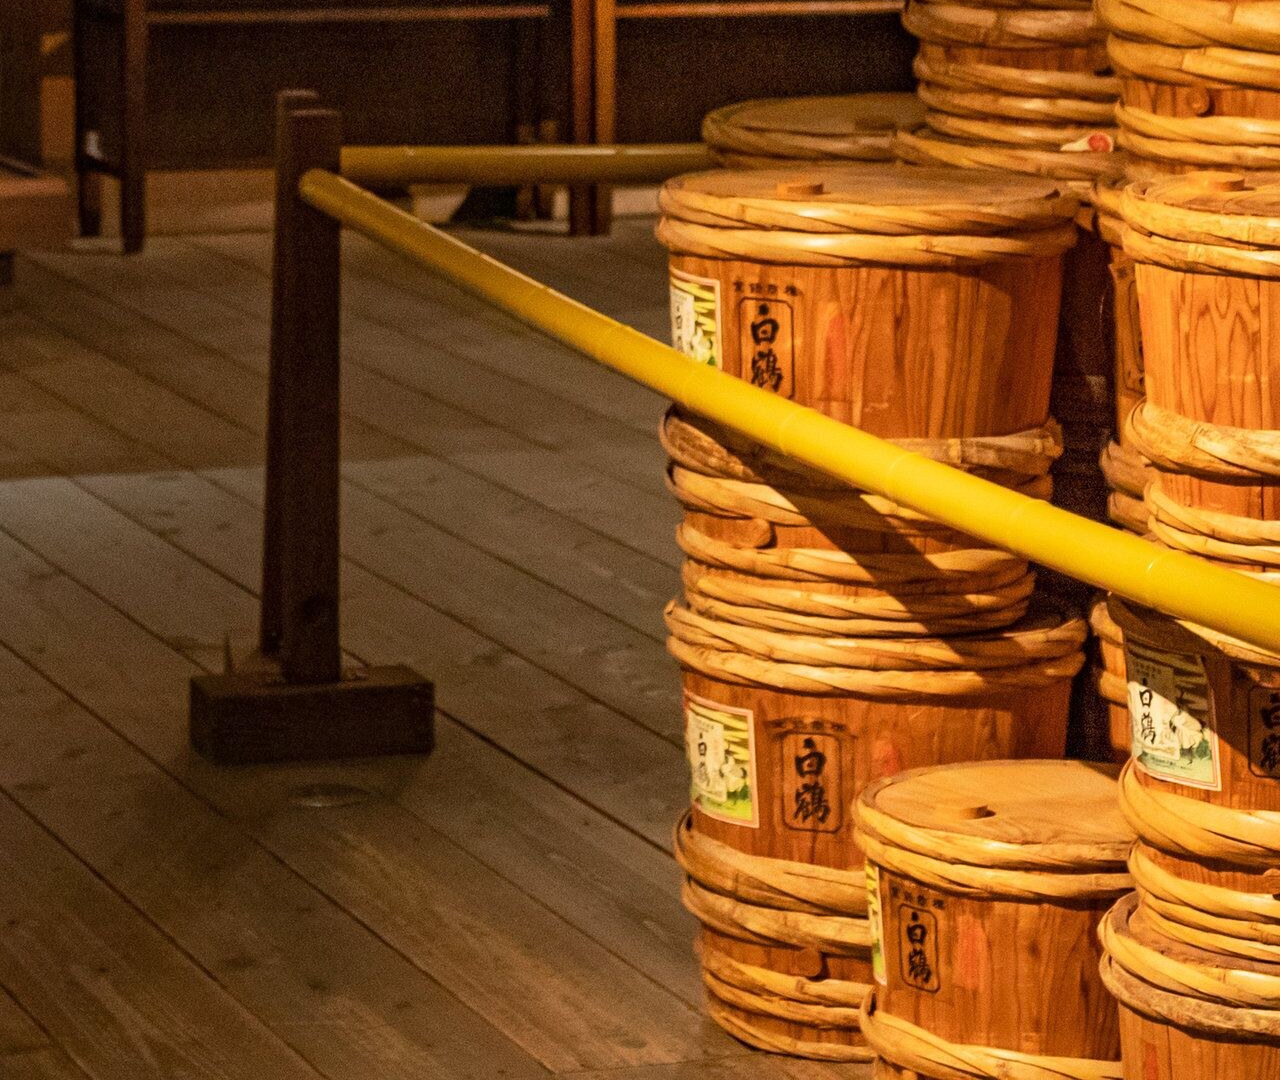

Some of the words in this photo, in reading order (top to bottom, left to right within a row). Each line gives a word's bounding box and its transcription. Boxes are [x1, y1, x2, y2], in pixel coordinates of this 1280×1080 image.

[750, 302, 784, 393] 白鶴
[1138, 677, 1157, 745] 白鶴
[793, 737, 831, 824] 白鶴
[905, 911, 933, 985] 白鶴
